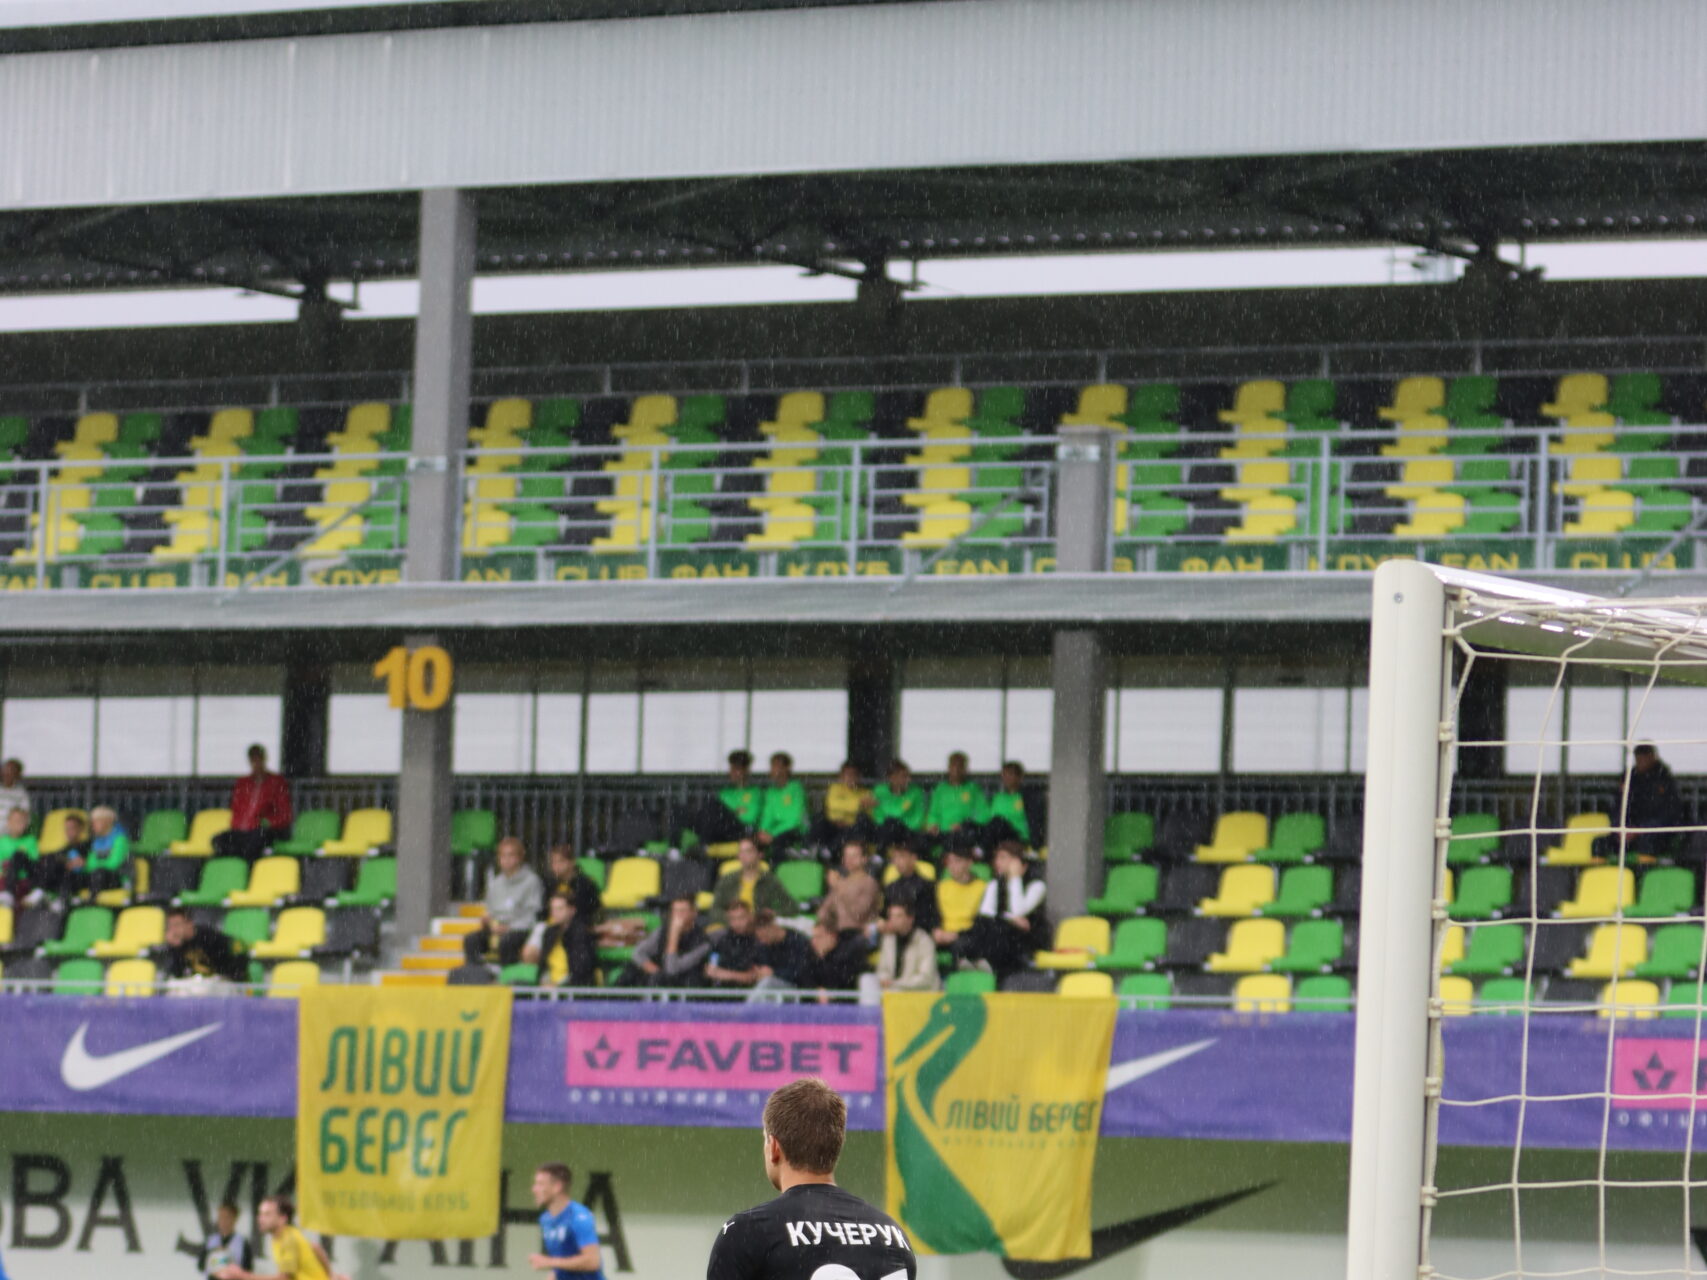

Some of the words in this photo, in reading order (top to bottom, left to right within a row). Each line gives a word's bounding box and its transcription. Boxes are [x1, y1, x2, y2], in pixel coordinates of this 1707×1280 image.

[373, 645, 453, 711] 10
[636, 1038, 862, 1074] FAVBET
[319, 1106, 468, 1178] БЕРЕГ
[0, 1153, 144, 1255] ВА
[786, 1220, 911, 1251] КУЧЕРУК
